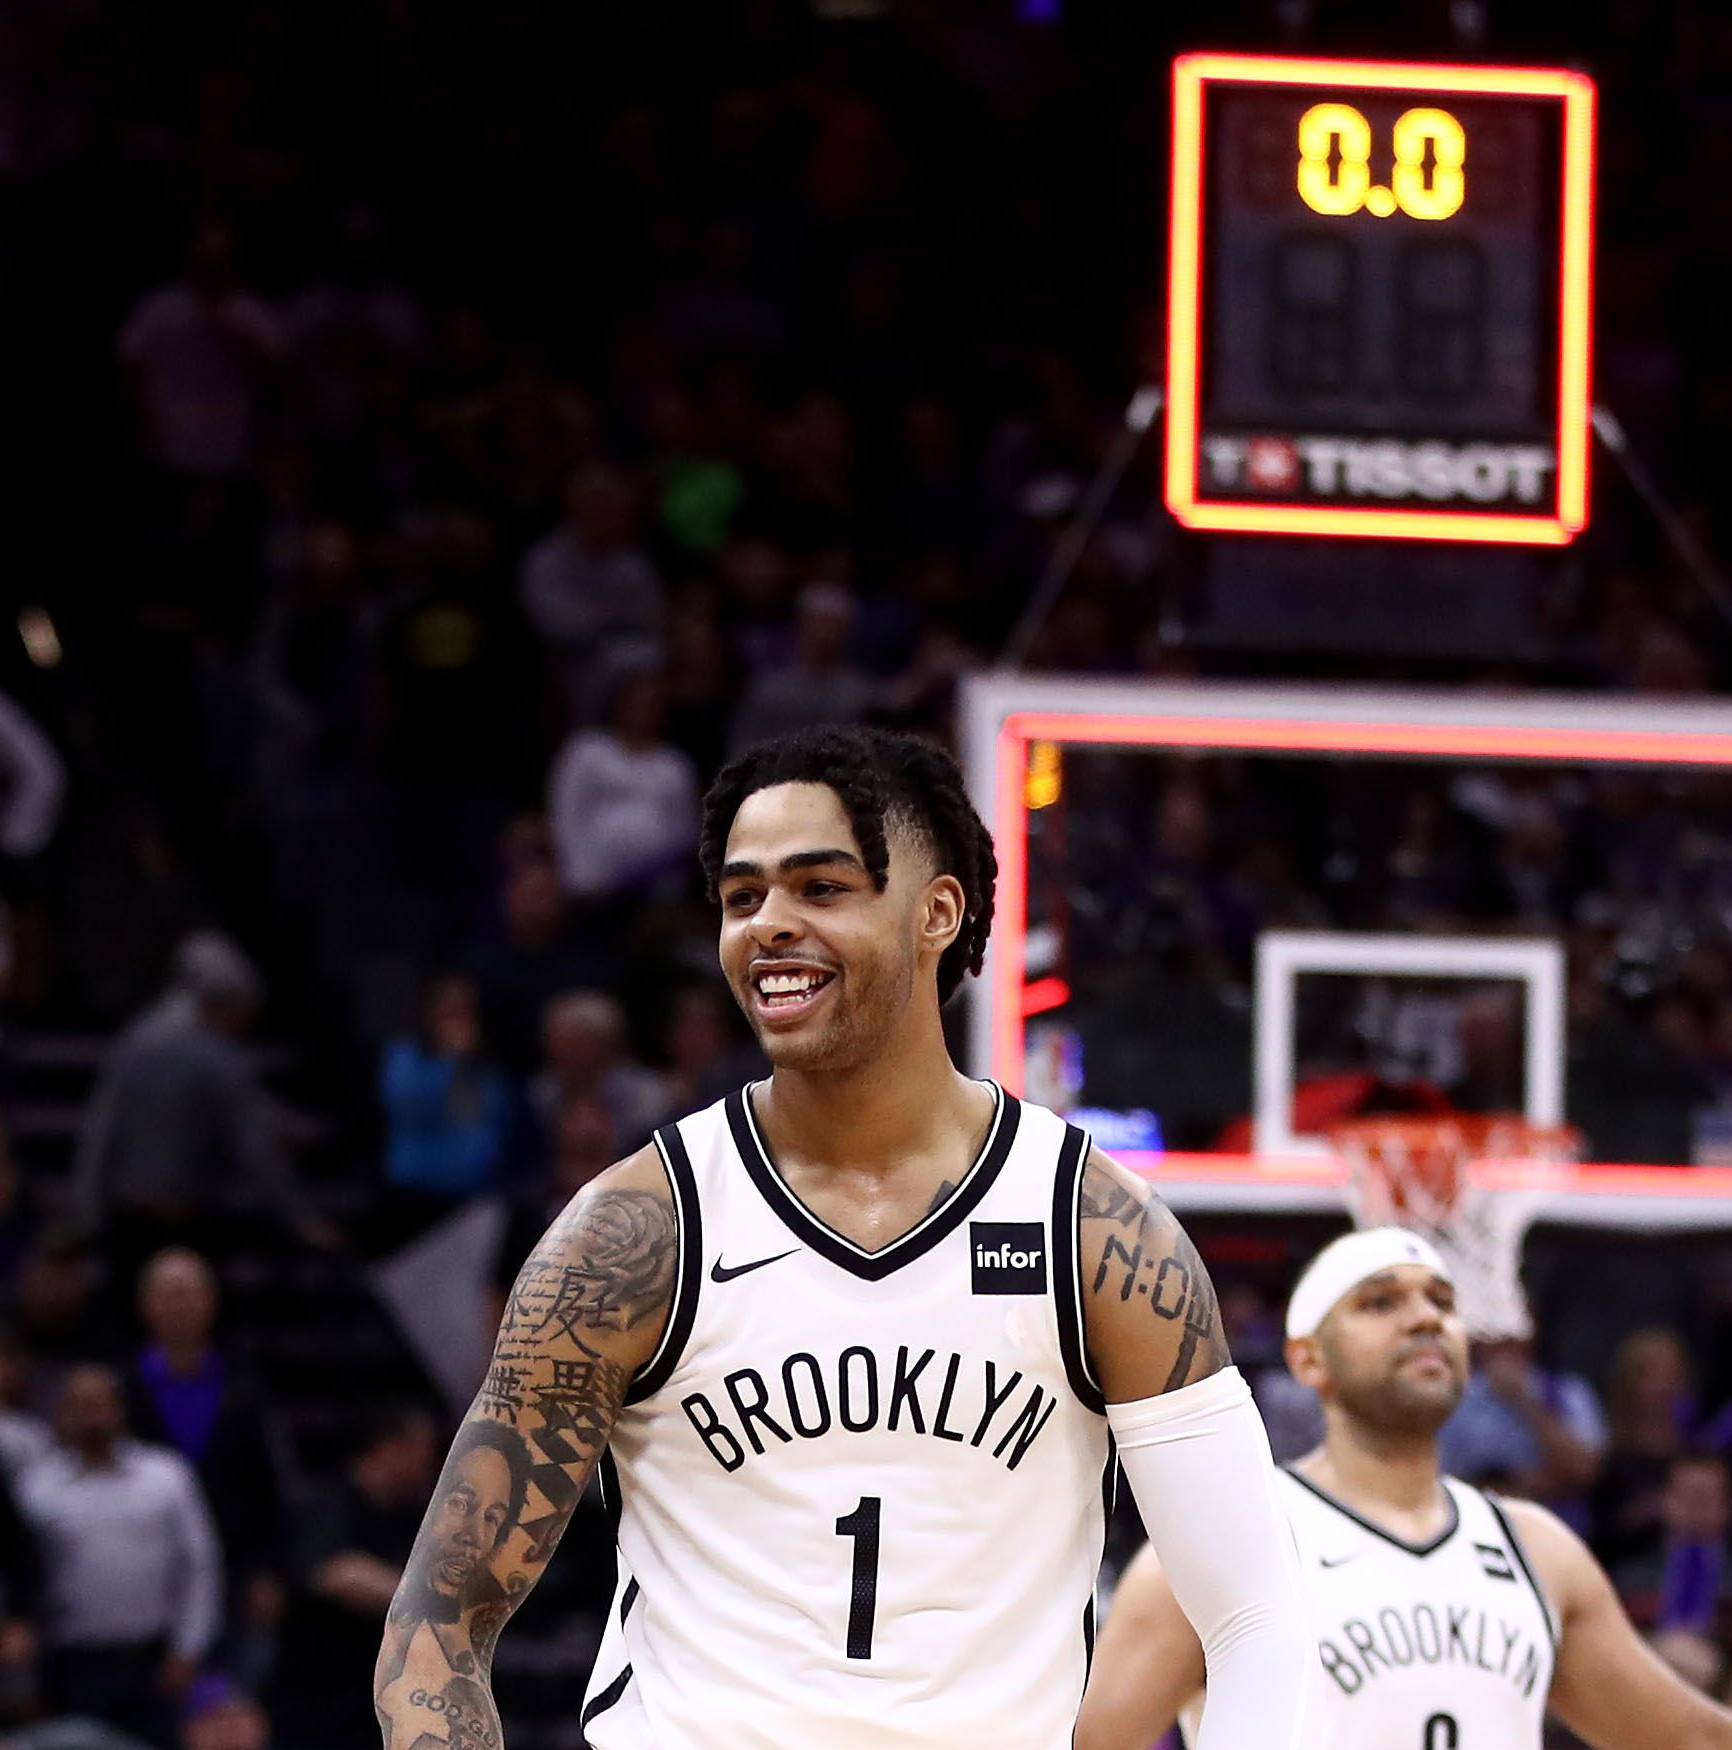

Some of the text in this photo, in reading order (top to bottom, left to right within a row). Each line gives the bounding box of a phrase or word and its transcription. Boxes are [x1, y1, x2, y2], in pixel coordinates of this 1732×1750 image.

[1298, 103, 1464, 220] 0.0
[1299, 440, 1551, 502] TISSOT
[977, 1243, 1041, 1269] infor
[680, 1345, 1057, 1473] BROOKLYN
[835, 1497, 882, 1659] 1
[1319, 1605, 1543, 1699] BROOKLYN
[409, 1688, 461, 1720] GOD
